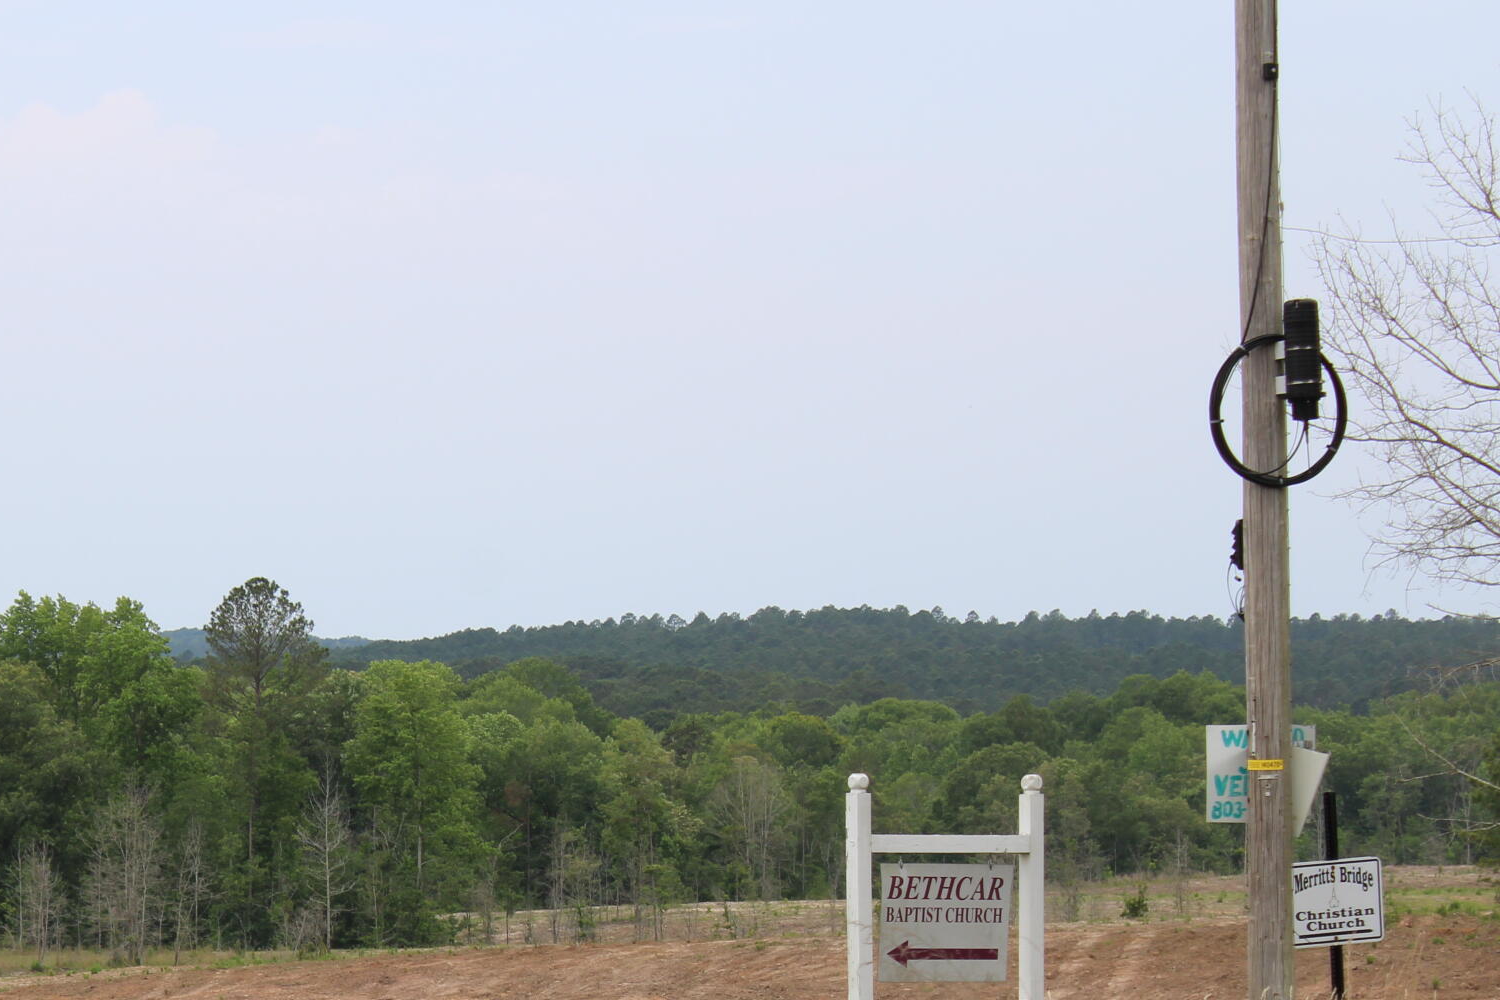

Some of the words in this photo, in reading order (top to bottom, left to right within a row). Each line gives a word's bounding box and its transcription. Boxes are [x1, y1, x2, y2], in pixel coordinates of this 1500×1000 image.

[1340, 866, 1374, 892] Bridge
[887, 875, 1004, 901] BETHCAR
[886, 906, 943, 923] BAPTIST
[945, 907, 1003, 923] CHURCH
[1295, 907, 1375, 922] Christian
[1306, 918, 1365, 932] Church
